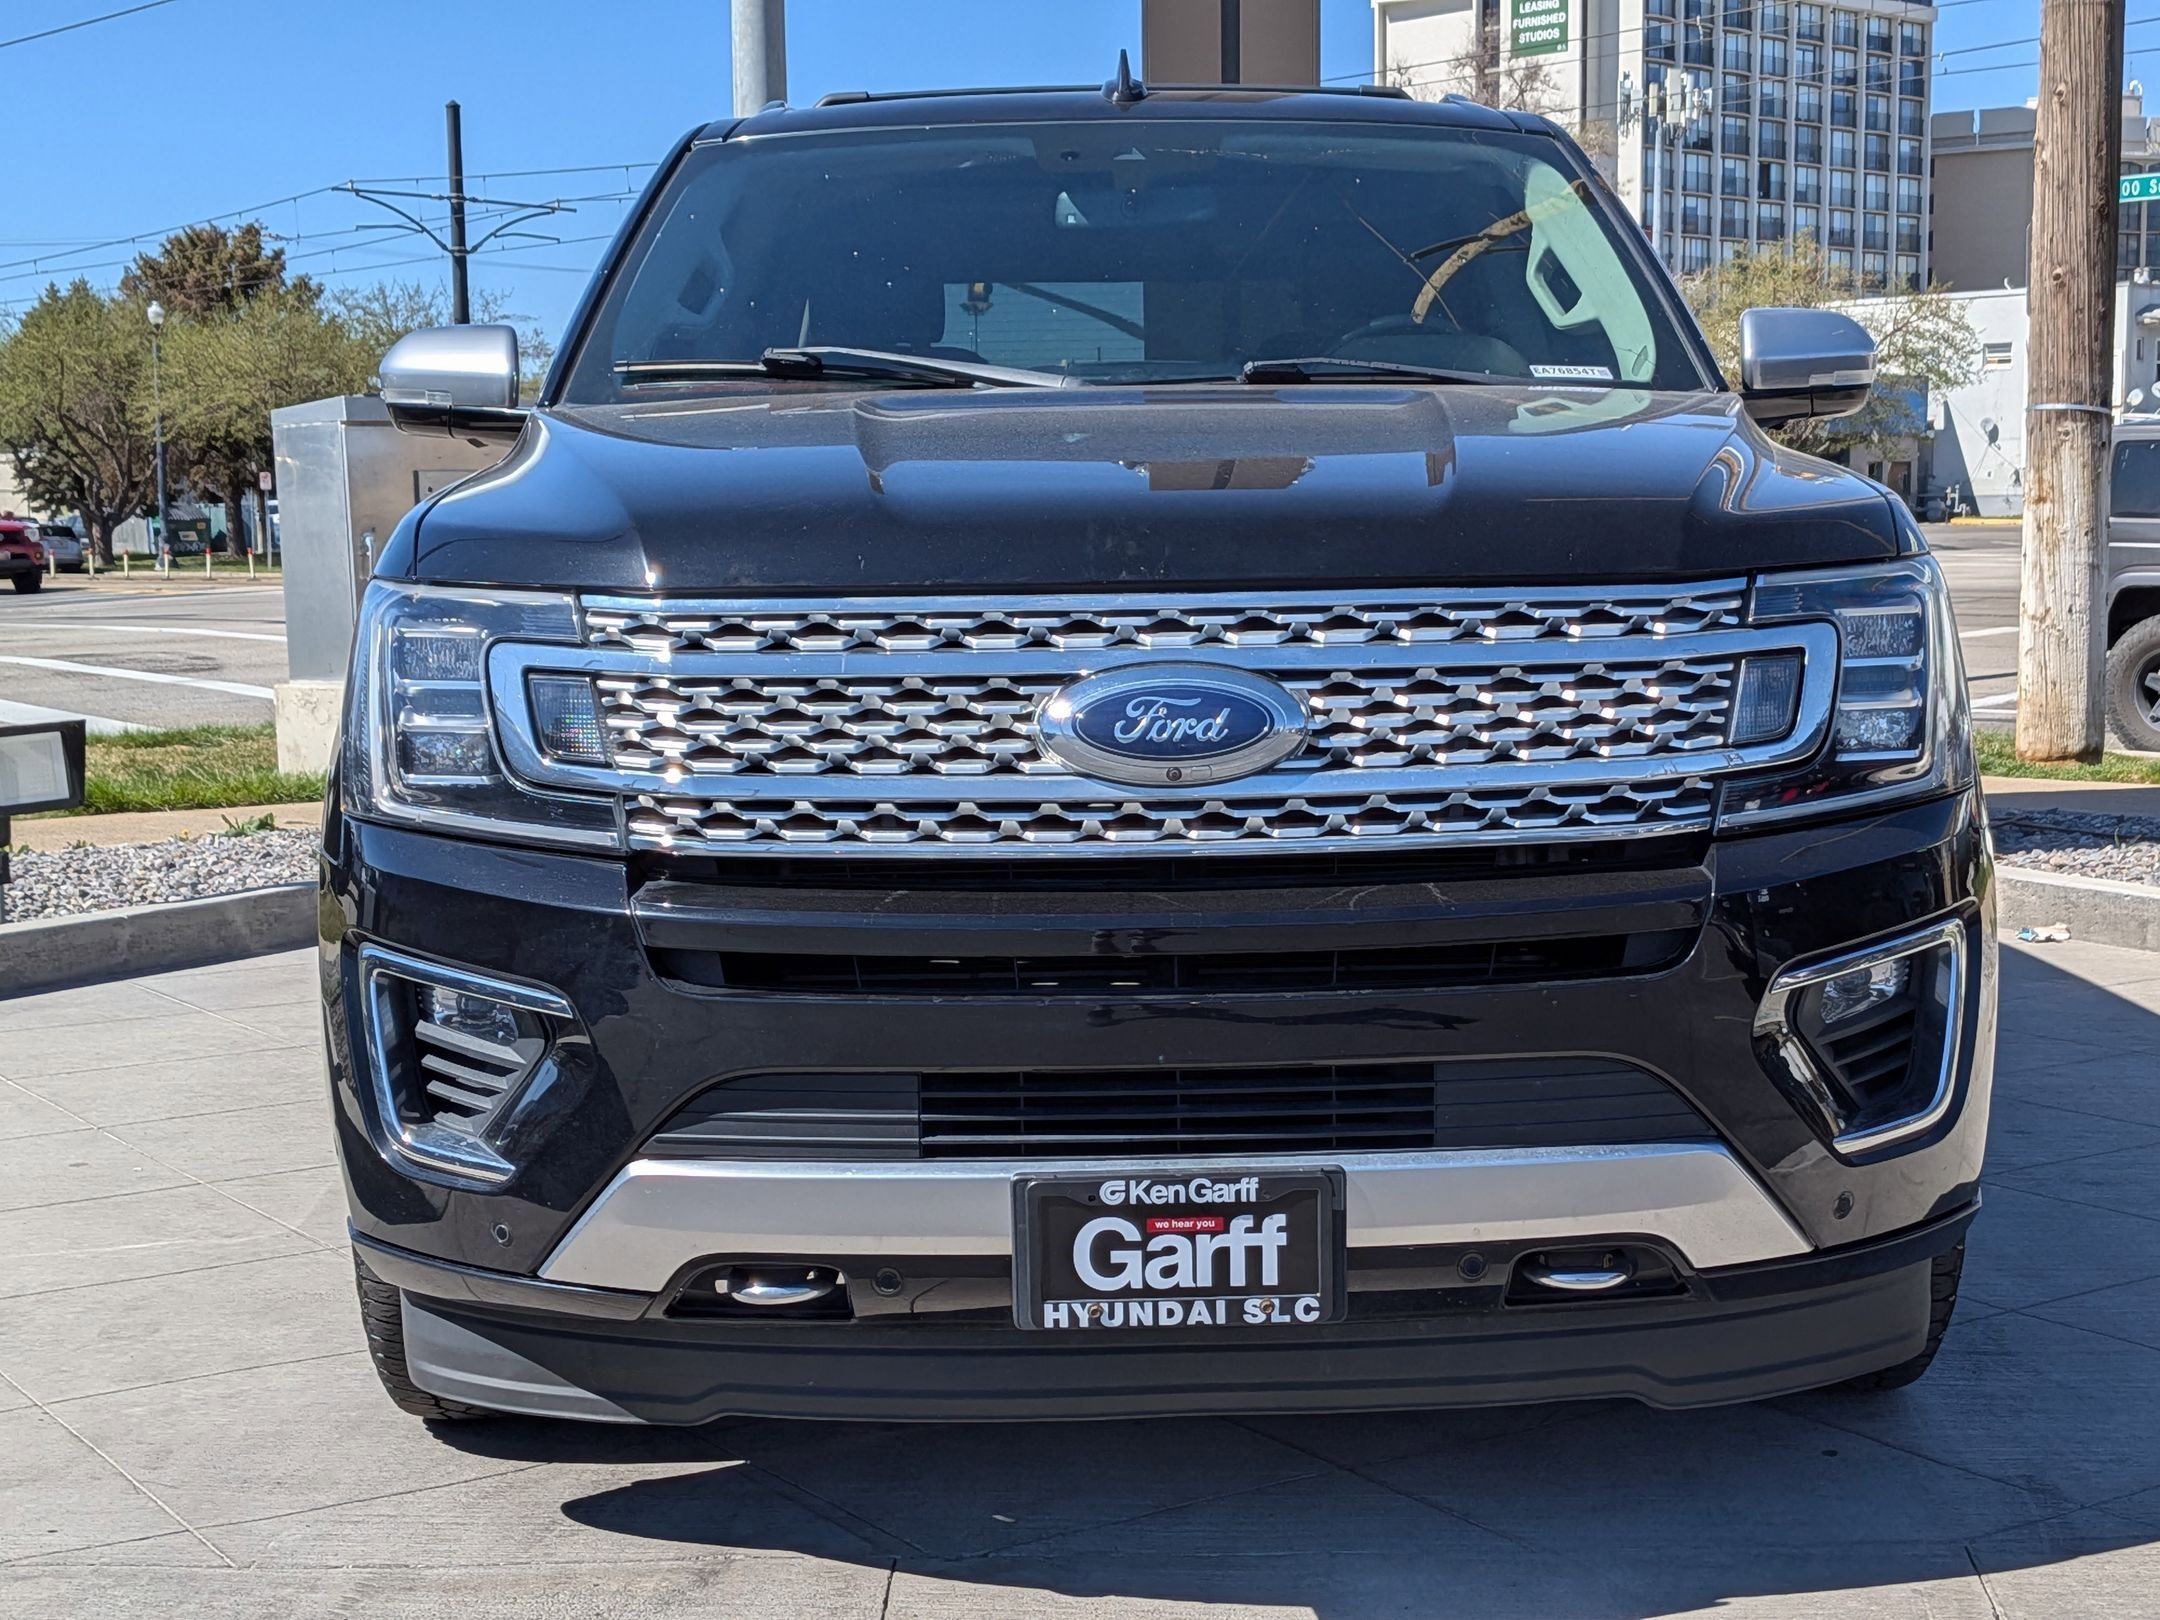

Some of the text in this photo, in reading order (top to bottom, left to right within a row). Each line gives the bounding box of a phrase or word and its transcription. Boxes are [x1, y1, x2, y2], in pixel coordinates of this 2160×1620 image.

[1519, 0, 1560, 13] LEASING
[1512, 11, 1567, 30] FURNISHED
[1518, 27, 1560, 44] STUDIOS
[2149, 178, 2160, 194] S
[1113, 695, 1231, 744] Ford
[1154, 1219, 1216, 1230] we hear you
[1072, 1213, 1288, 1292] Garff
[1043, 1296, 1321, 1329] HYUNDAI SLC
